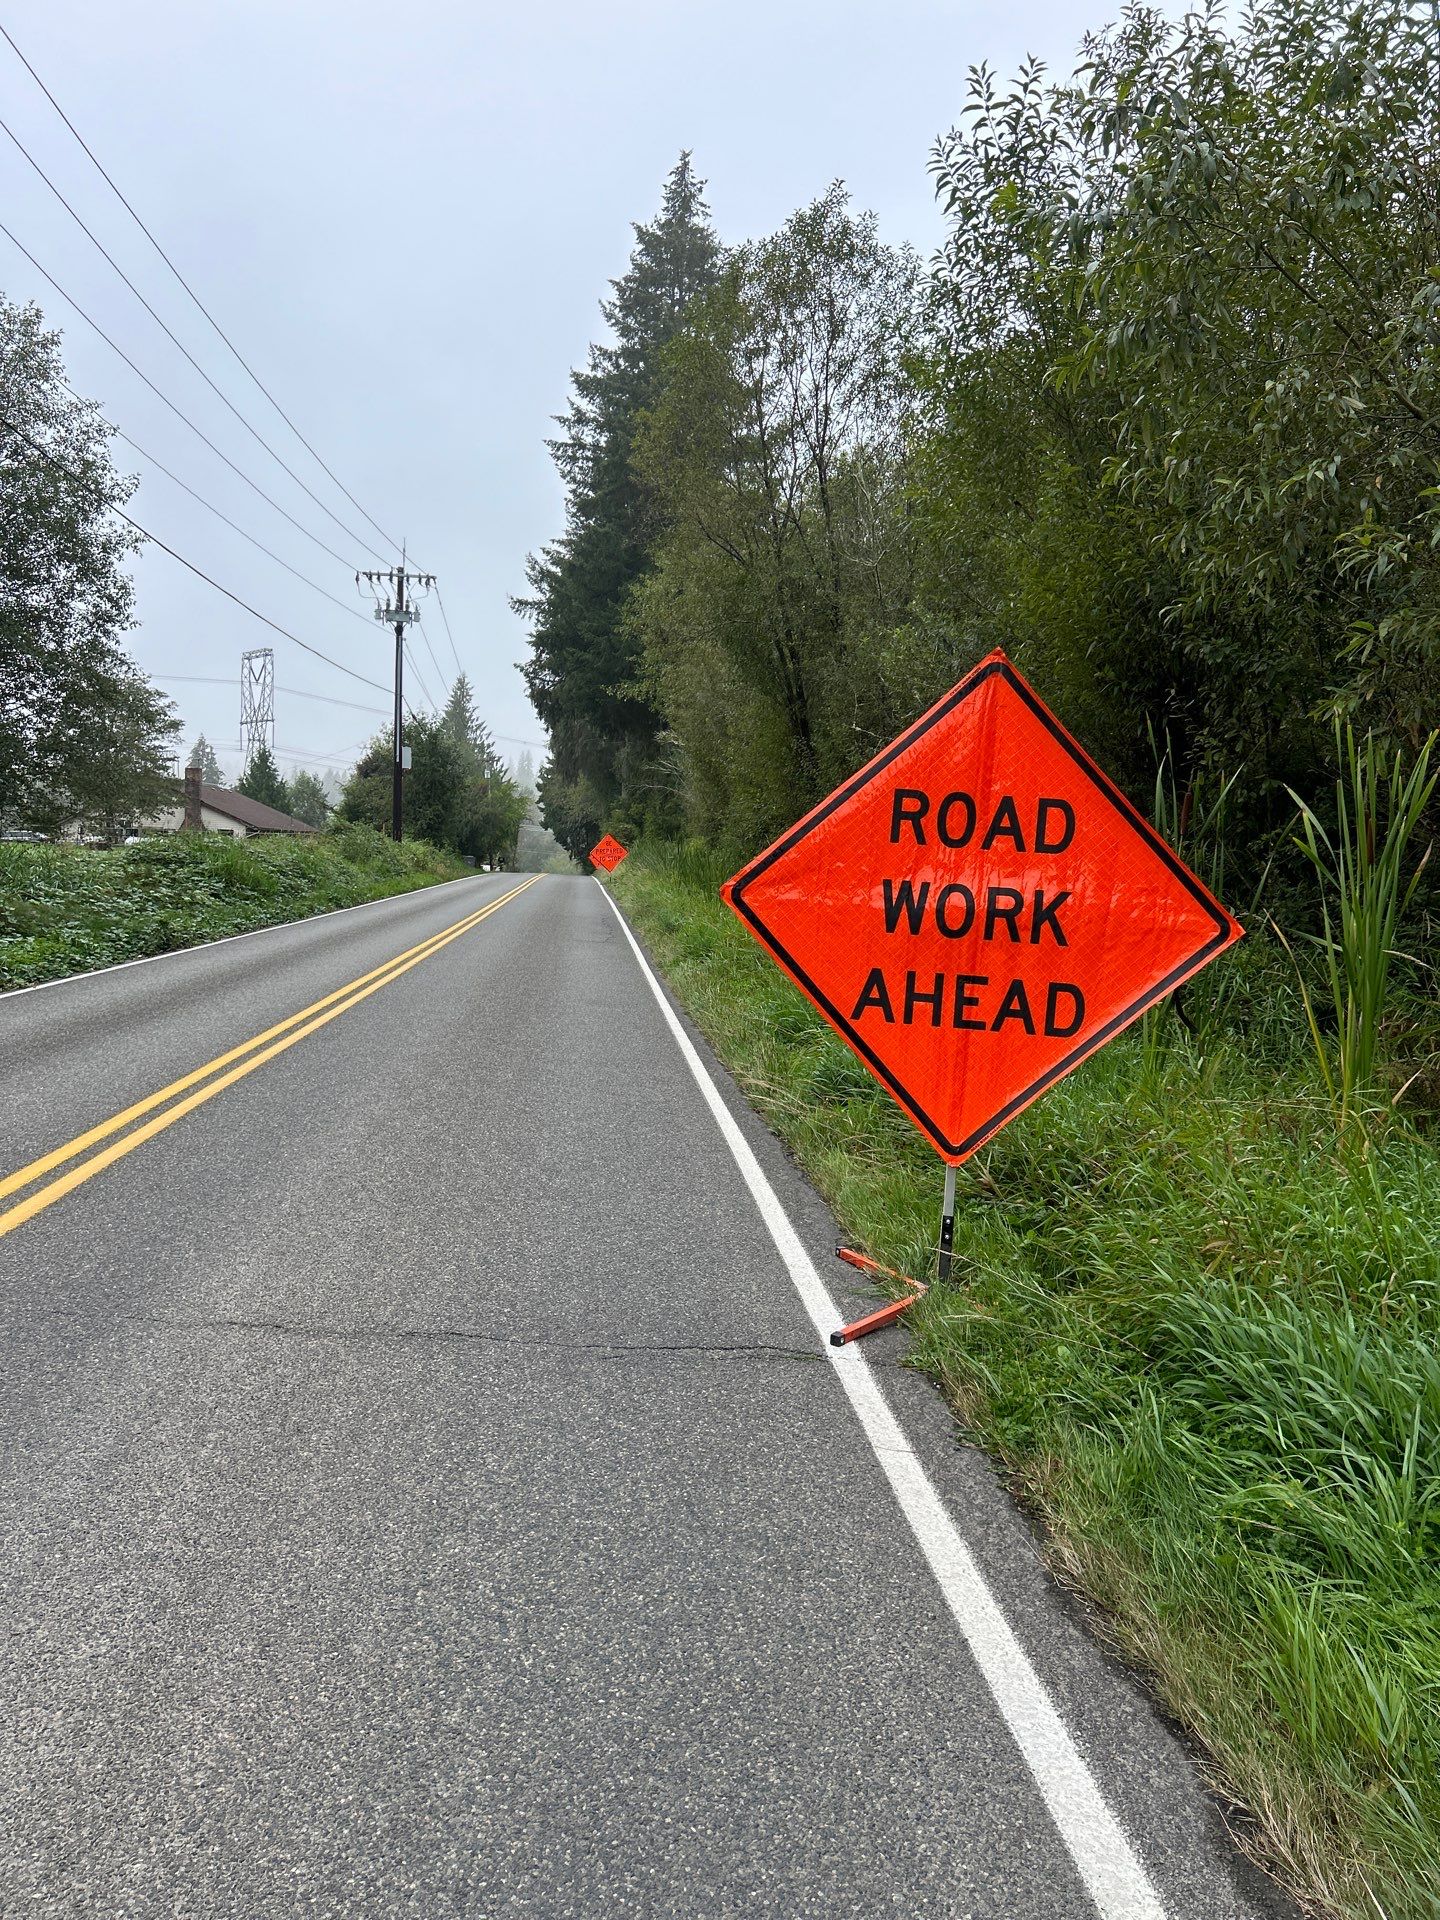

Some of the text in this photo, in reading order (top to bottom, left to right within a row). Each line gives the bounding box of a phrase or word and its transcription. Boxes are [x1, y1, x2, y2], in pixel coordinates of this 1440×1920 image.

[889, 788, 1076, 855] ROAD
[882, 878, 1072, 947] WORK
[850, 967, 1086, 1038] AHEAD
